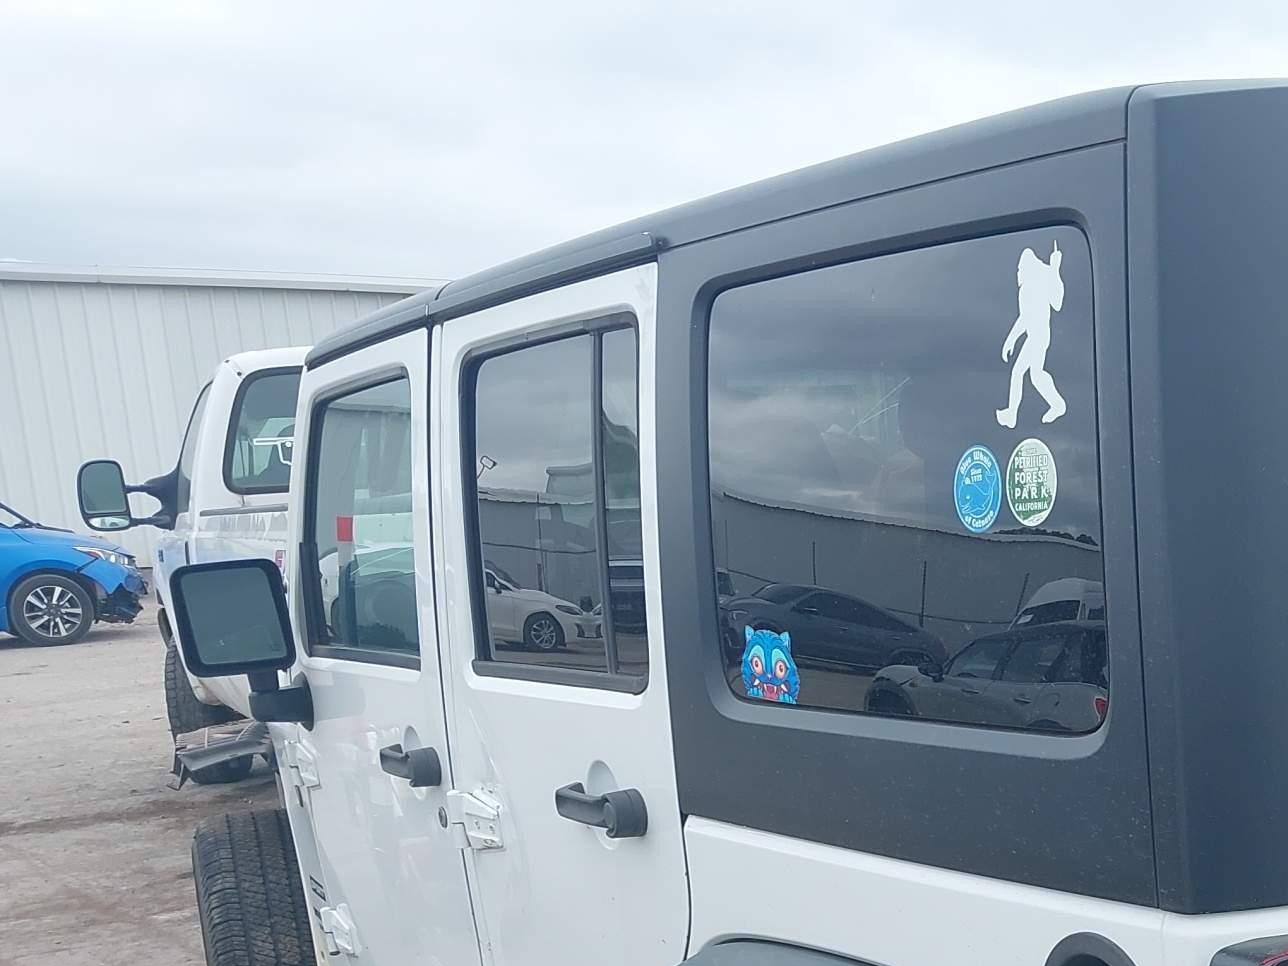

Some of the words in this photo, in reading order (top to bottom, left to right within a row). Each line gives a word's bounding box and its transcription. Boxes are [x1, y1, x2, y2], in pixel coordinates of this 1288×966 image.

[1014, 470, 1048, 485] FOREST
[1014, 485, 1049, 500] PARK
[1014, 500, 1049, 512] CALIFORNIA
